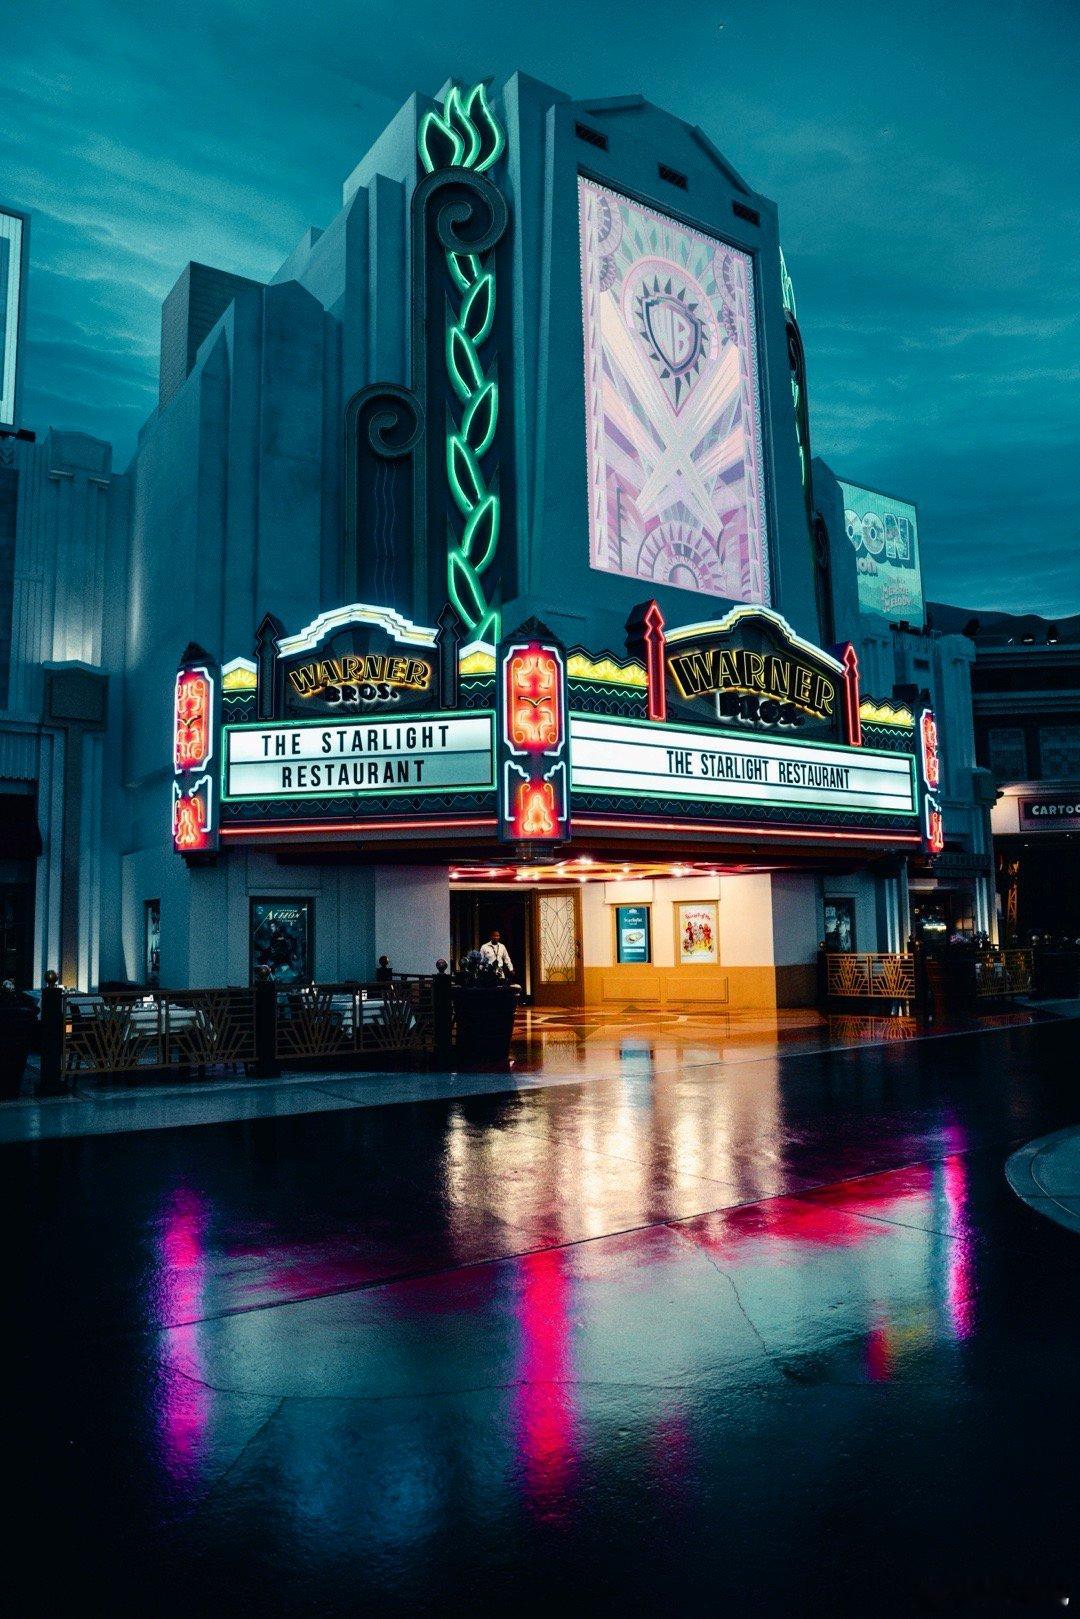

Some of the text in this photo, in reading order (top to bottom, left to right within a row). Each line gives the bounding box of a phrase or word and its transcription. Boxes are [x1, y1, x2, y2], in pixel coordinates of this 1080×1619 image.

[651, 304, 692, 362] WB
[289, 655, 431, 694] WARNER
[324, 682, 400, 703] BROS.
[669, 650, 835, 717] WARNER
[262, 725, 450, 756] THE STARLIGHT
[282, 760, 425, 788] RESTAURANT
[667, 750, 850, 789] THE STARLIGHT RESTAURANT
